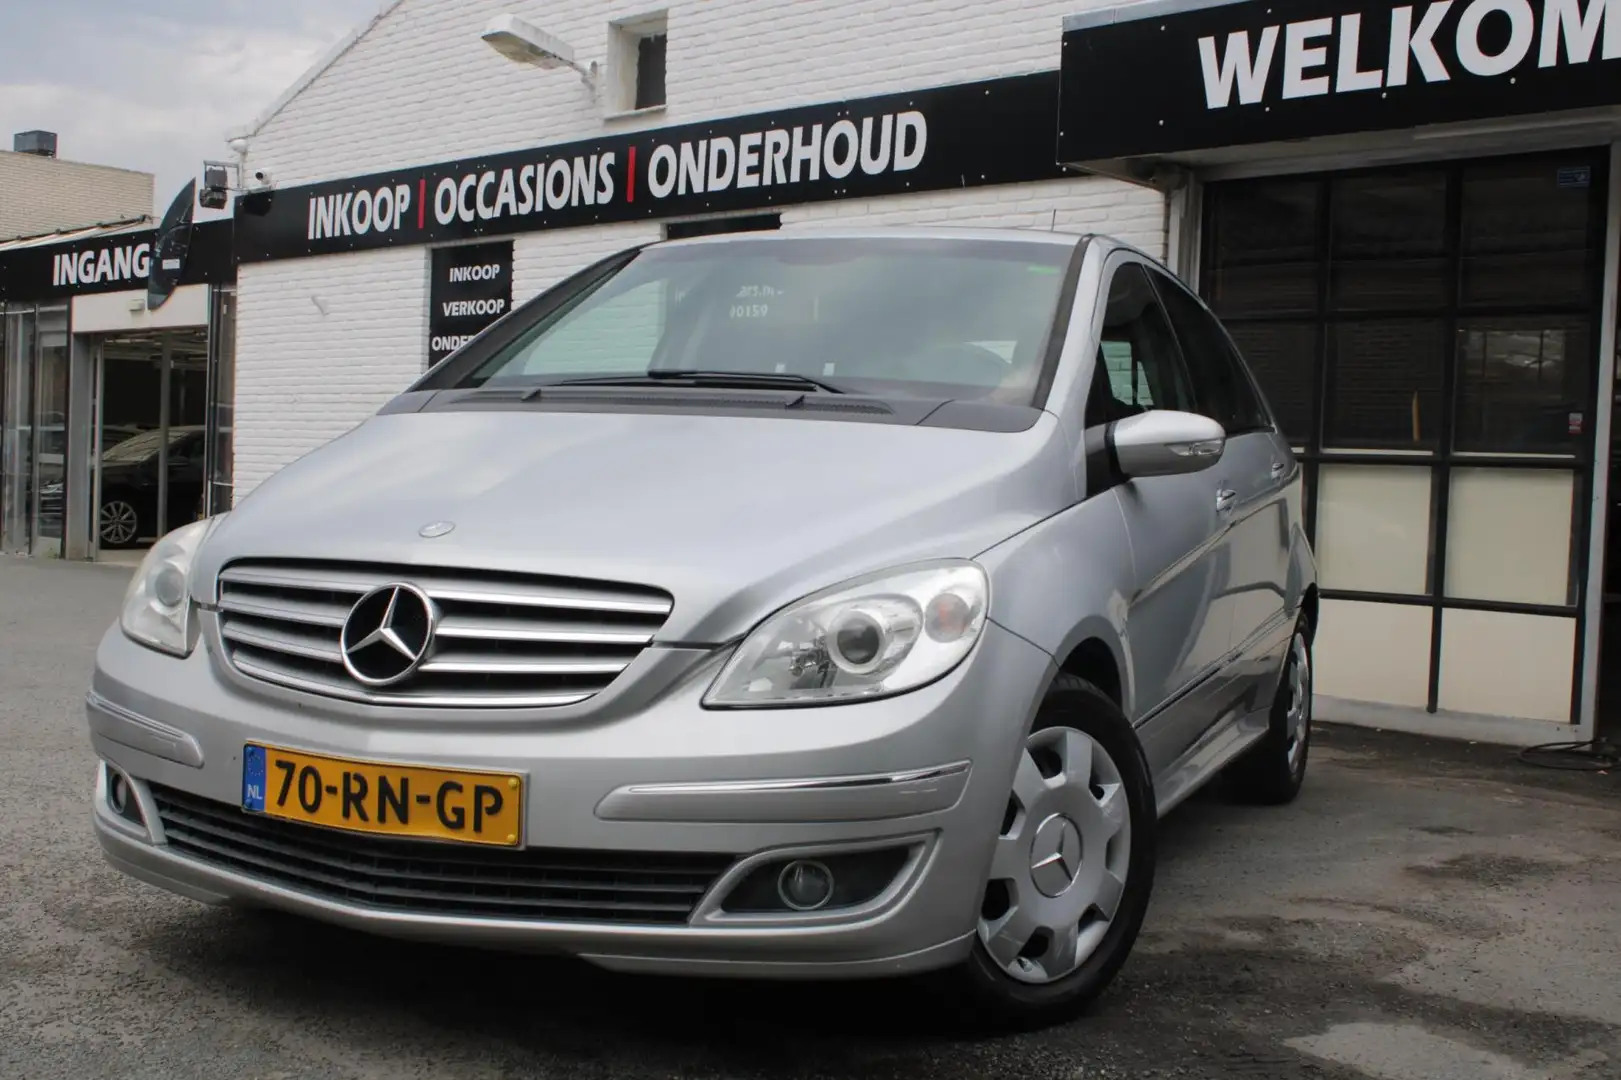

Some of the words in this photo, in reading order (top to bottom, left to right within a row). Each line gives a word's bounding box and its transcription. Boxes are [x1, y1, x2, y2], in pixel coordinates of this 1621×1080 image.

[1197, 0, 1621, 110] WELKOM
[307, 184, 411, 240] INKOOP
[434, 151, 615, 226] OCCASIONS
[647, 110, 928, 199] ONDERHOUD
[53, 243, 150, 286] INGANG
[449, 264, 501, 283] INKOOP
[443, 299, 505, 317] VERKOOP
[431, 335, 475, 351] ONDE
[247, 783, 263, 801] NL
[275, 760, 504, 834] 70-RN-GP
